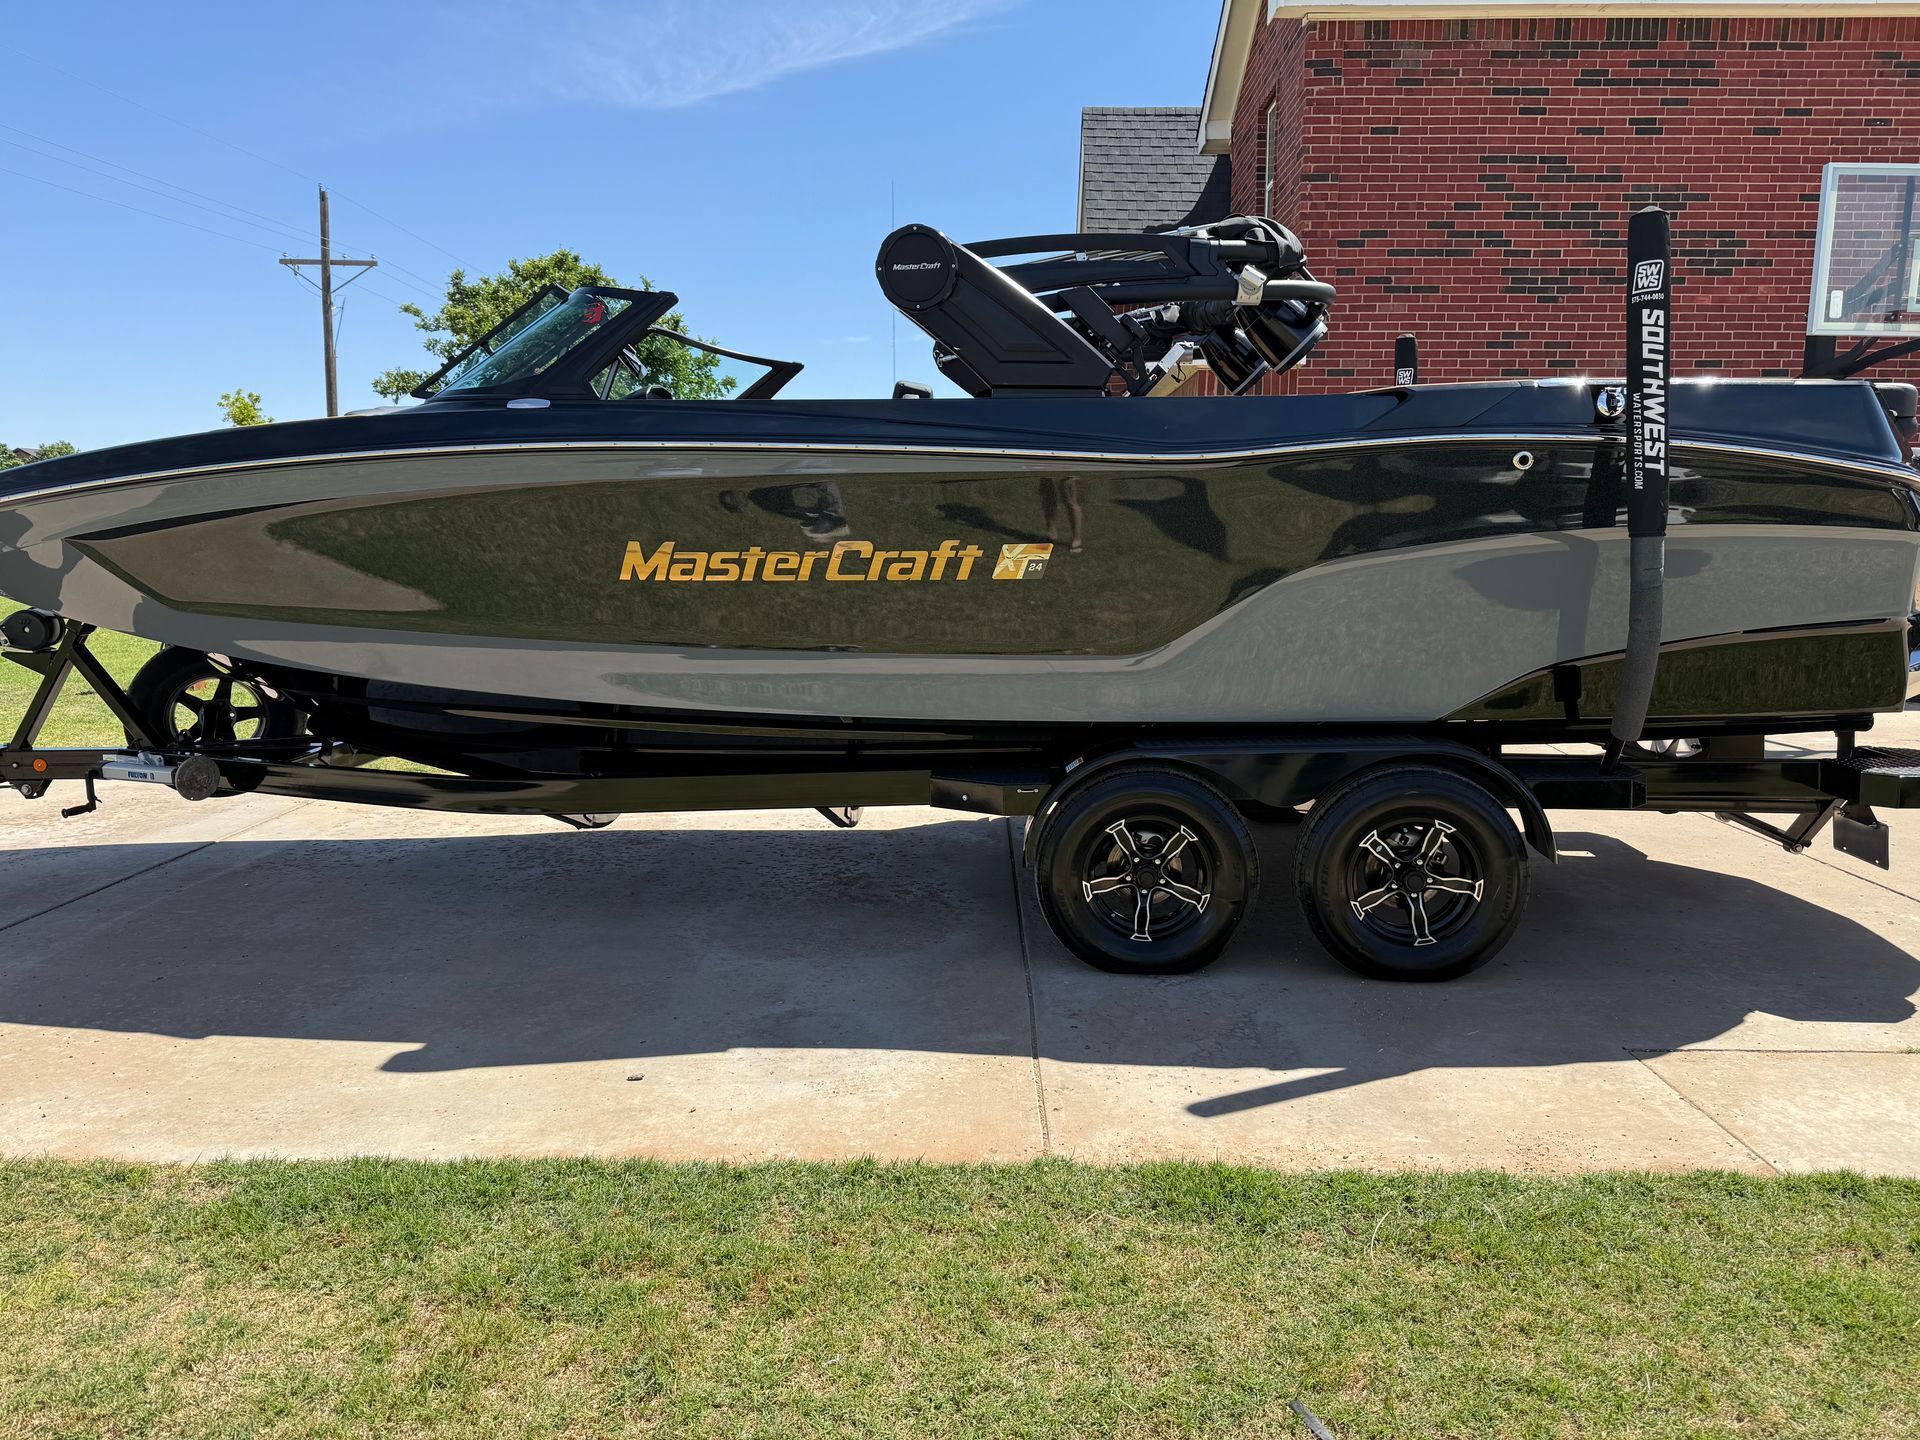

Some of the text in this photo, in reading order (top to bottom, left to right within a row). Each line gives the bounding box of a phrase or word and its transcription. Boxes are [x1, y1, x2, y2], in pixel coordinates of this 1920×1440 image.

[892, 261, 941, 271] MasterCraft
[1637, 263, 1661, 278] SW
[1637, 275, 1659, 289] WS
[1398, 370, 1412, 378] SW
[1641, 308, 1666, 477] SOUTHWEST
[1632, 392, 1644, 490] WATERSPORTS.COM
[619, 539, 983, 581] MasterCraft
[1028, 562, 1044, 572] 24
